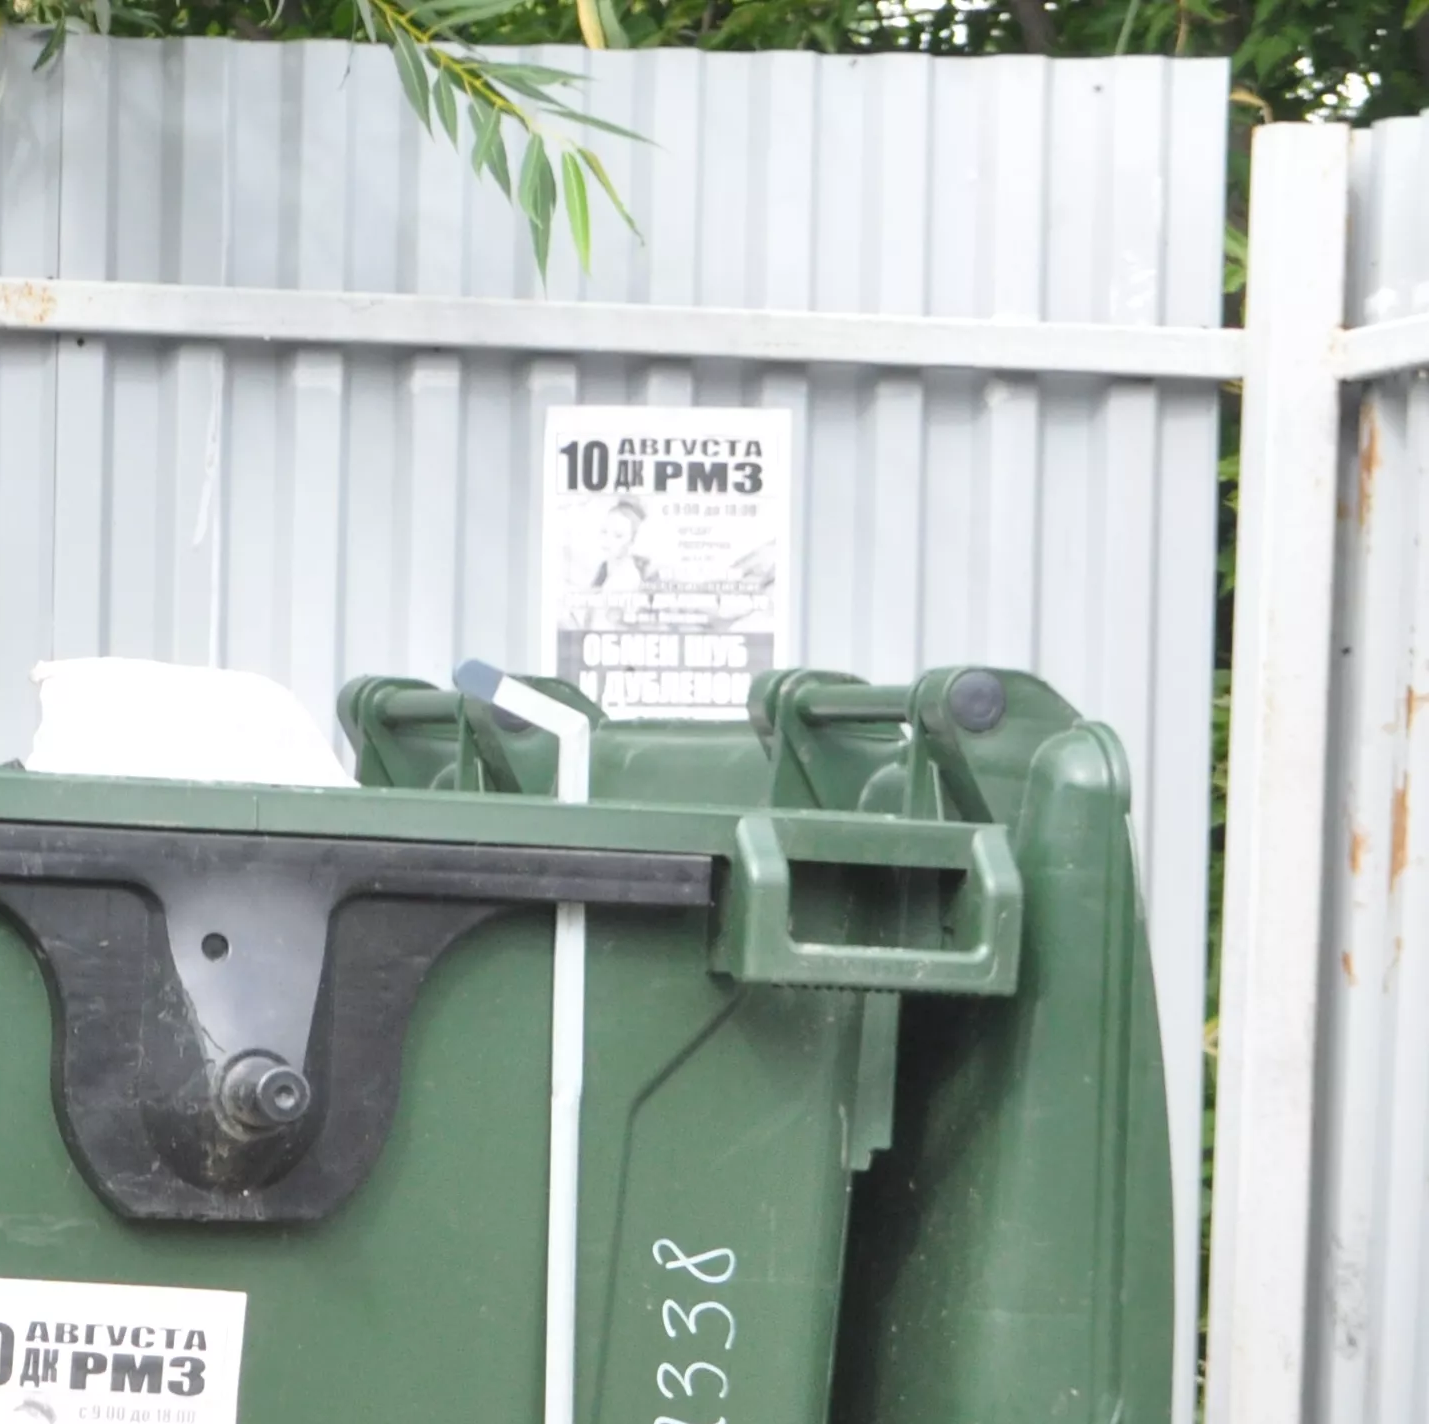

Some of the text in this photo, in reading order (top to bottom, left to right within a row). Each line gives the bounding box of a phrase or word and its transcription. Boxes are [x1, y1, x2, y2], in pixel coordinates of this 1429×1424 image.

[559, 438, 763, 492] 10 АВГУСТА
[614, 458, 763, 494] ДК РМЗ
[583, 633, 748, 668] ОБМЕН ШУБ
[579, 670, 751, 708] И ДУБЛЕНОК
[25, 1321, 207, 1351] АВГУСТА
[19, 1348, 207, 1396] ДК РМЗ
